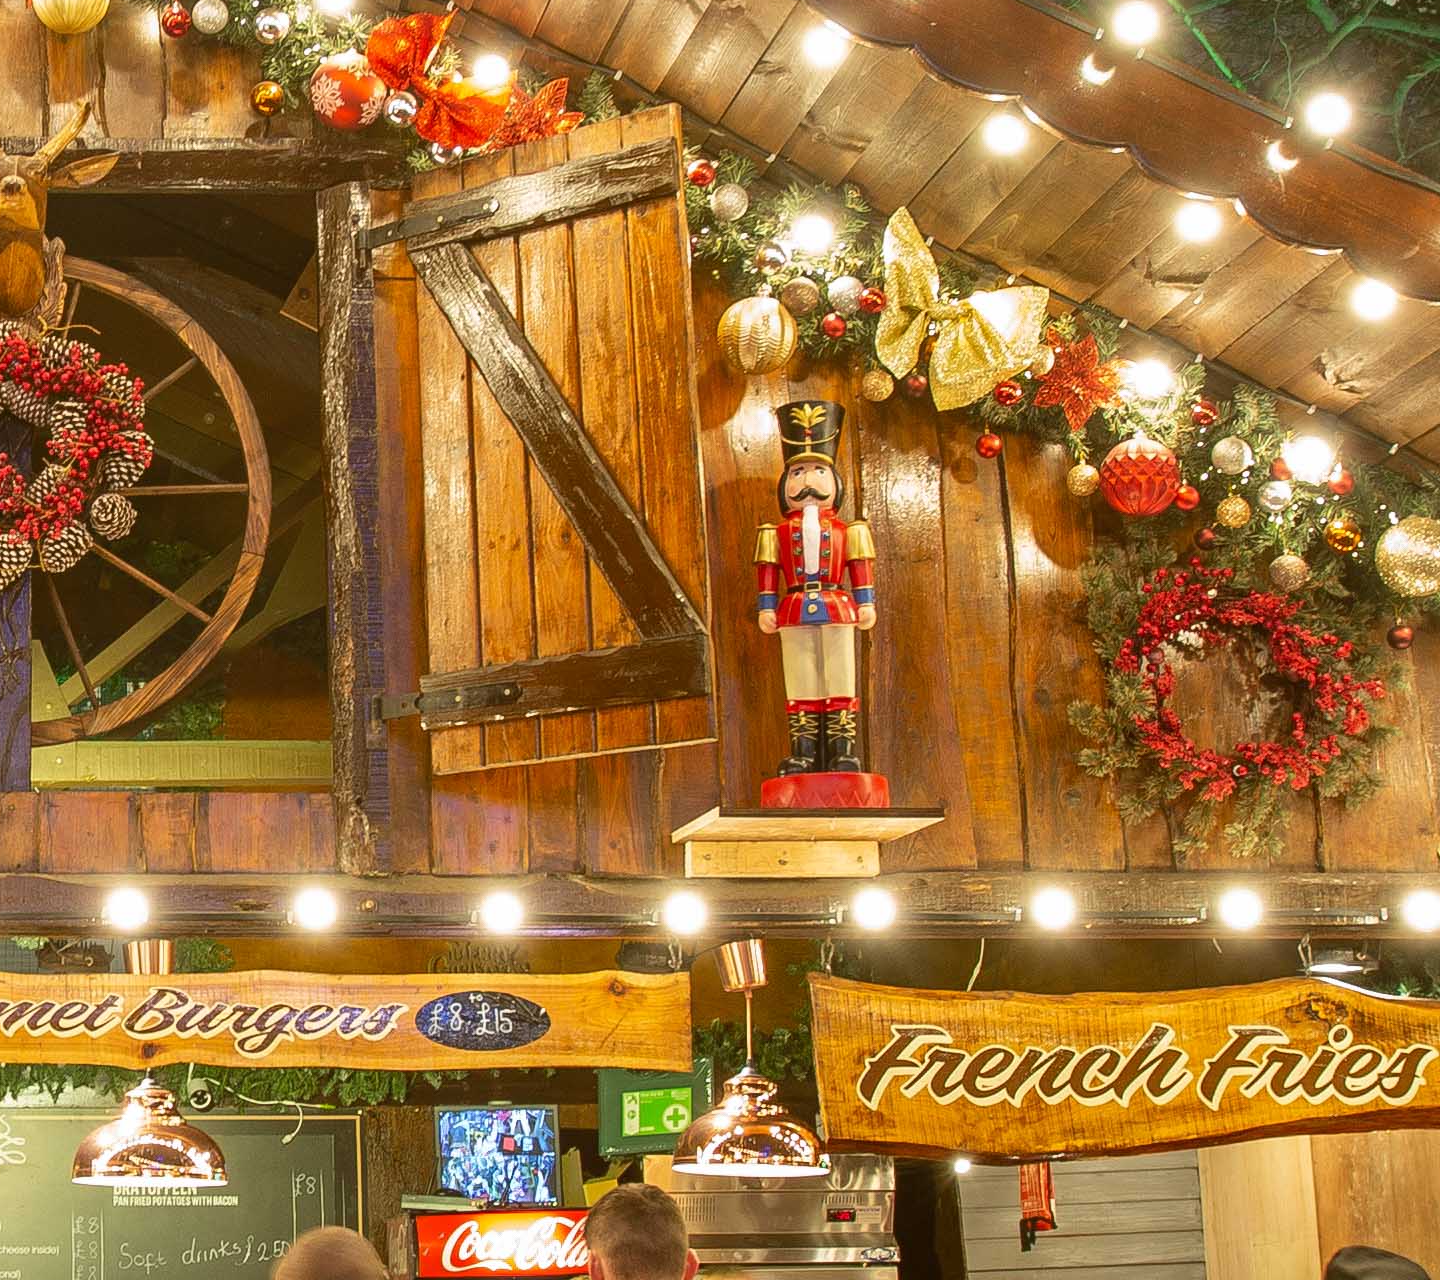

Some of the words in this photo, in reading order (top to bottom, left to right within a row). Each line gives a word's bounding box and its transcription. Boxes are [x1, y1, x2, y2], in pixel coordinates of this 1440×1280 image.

[123, 987, 409, 1060] Burgers
[858, 1022, 1193, 1112] French
[1198, 1022, 1440, 1112] Fries
[295, 1172, 317, 1197] £8
[113, 1195, 129, 1207] PAN
[129, 1195, 152, 1207] FRIED
[152, 1195, 192, 1207] POTATOES
[192, 1195, 213, 1207] WITH
[213, 1195, 239, 1207] BACON
[31, 1243, 61, 1256] inside)
[118, 1242, 168, 1275] Soft
[181, 1237, 242, 1266] drinks
